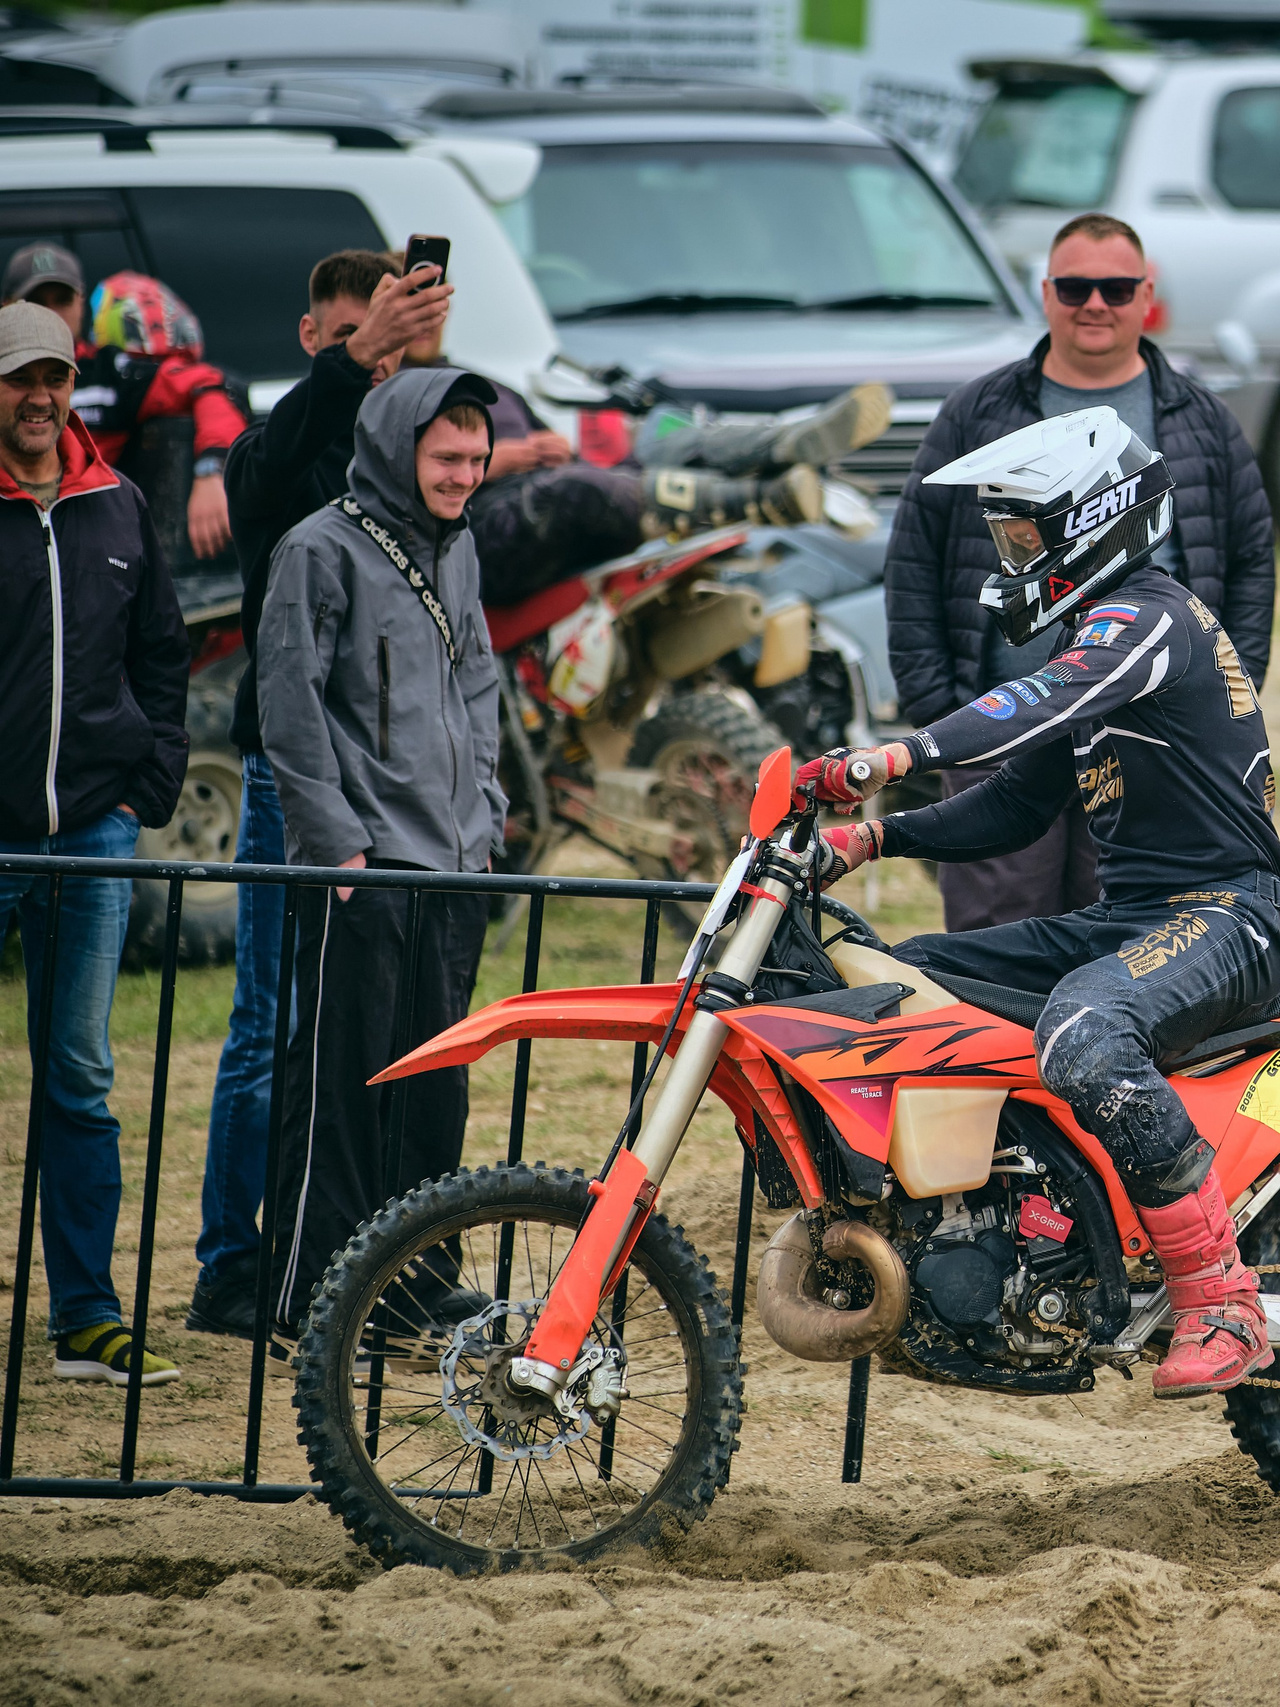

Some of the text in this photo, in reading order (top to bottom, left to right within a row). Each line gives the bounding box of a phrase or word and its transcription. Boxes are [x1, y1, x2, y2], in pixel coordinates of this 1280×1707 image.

[1064, 474, 1142, 539] LEATT
[361, 517, 409, 571] adidas
[850, 1086, 869, 1094] READY
[1028, 1209, 1066, 1232] X-GRIP
